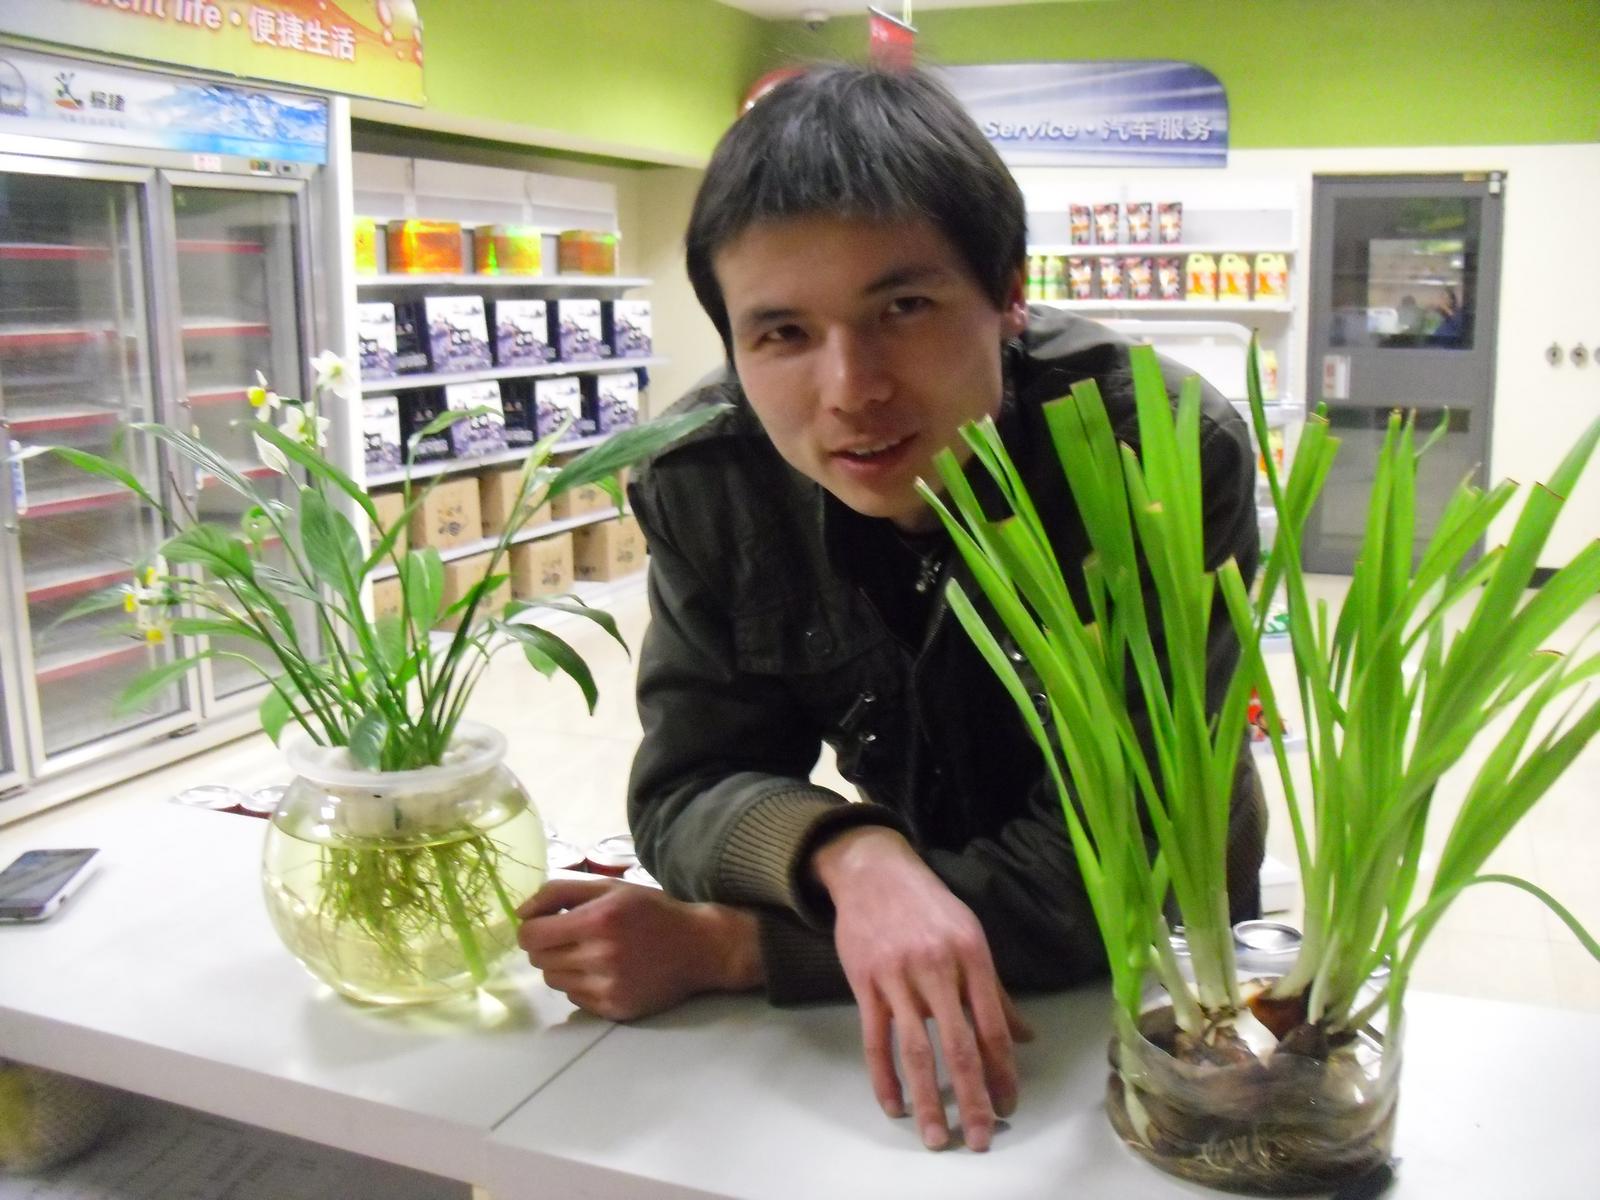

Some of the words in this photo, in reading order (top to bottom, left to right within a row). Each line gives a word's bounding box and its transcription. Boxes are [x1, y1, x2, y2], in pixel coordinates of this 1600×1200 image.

[174, 0, 223, 29] life
[248, 5, 356, 62] 便捷生活
[983, 120, 1078, 140] Service
[1102, 115, 1213, 142] 汽车服务
